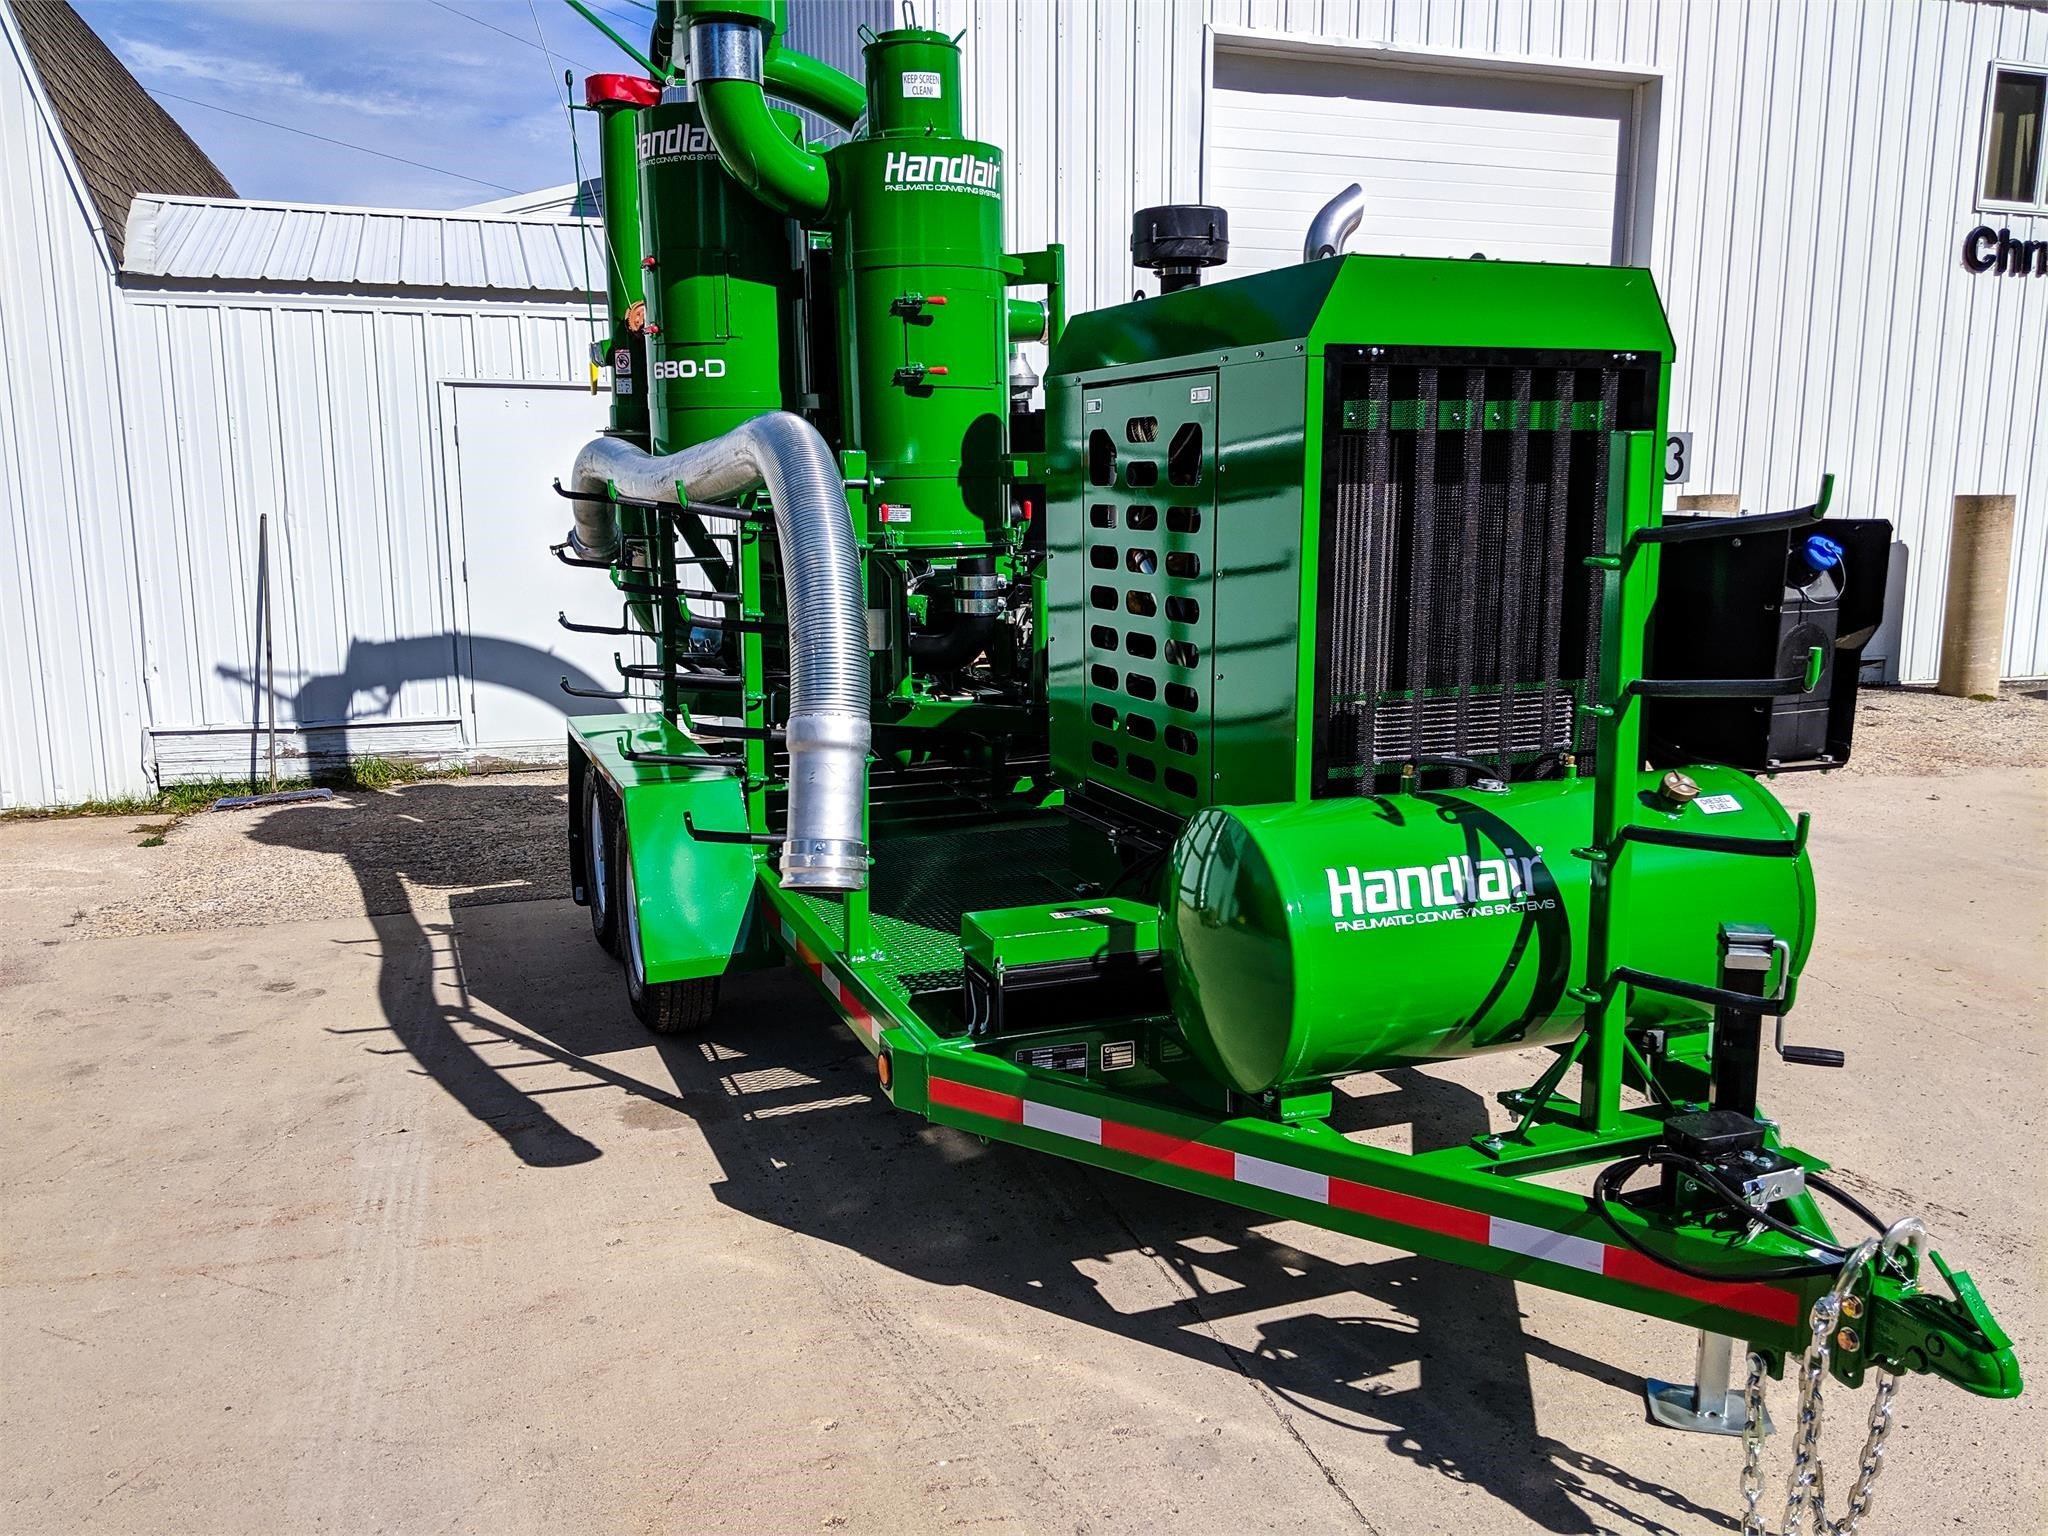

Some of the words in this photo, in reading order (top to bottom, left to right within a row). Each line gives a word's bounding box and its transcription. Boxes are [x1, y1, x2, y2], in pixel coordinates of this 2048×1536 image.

[903, 74, 918, 84] KEEP
[919, 74, 940, 85] SCREEN
[911, 85, 934, 96] CLEAN!
[656, 154, 696, 164] CONVEYING
[884, 152, 1000, 190] Handlair
[885, 184, 934, 192] PNEUMATIC
[934, 184, 979, 195] CONVEYING
[654, 359, 726, 380] 680-D
[1325, 848, 1542, 917] Handlair
[1335, 914, 1415, 933] PNEUMATIC
[1416, 905, 1494, 923] CONVEYING
[1494, 899, 1556, 915] SYSTEMS
